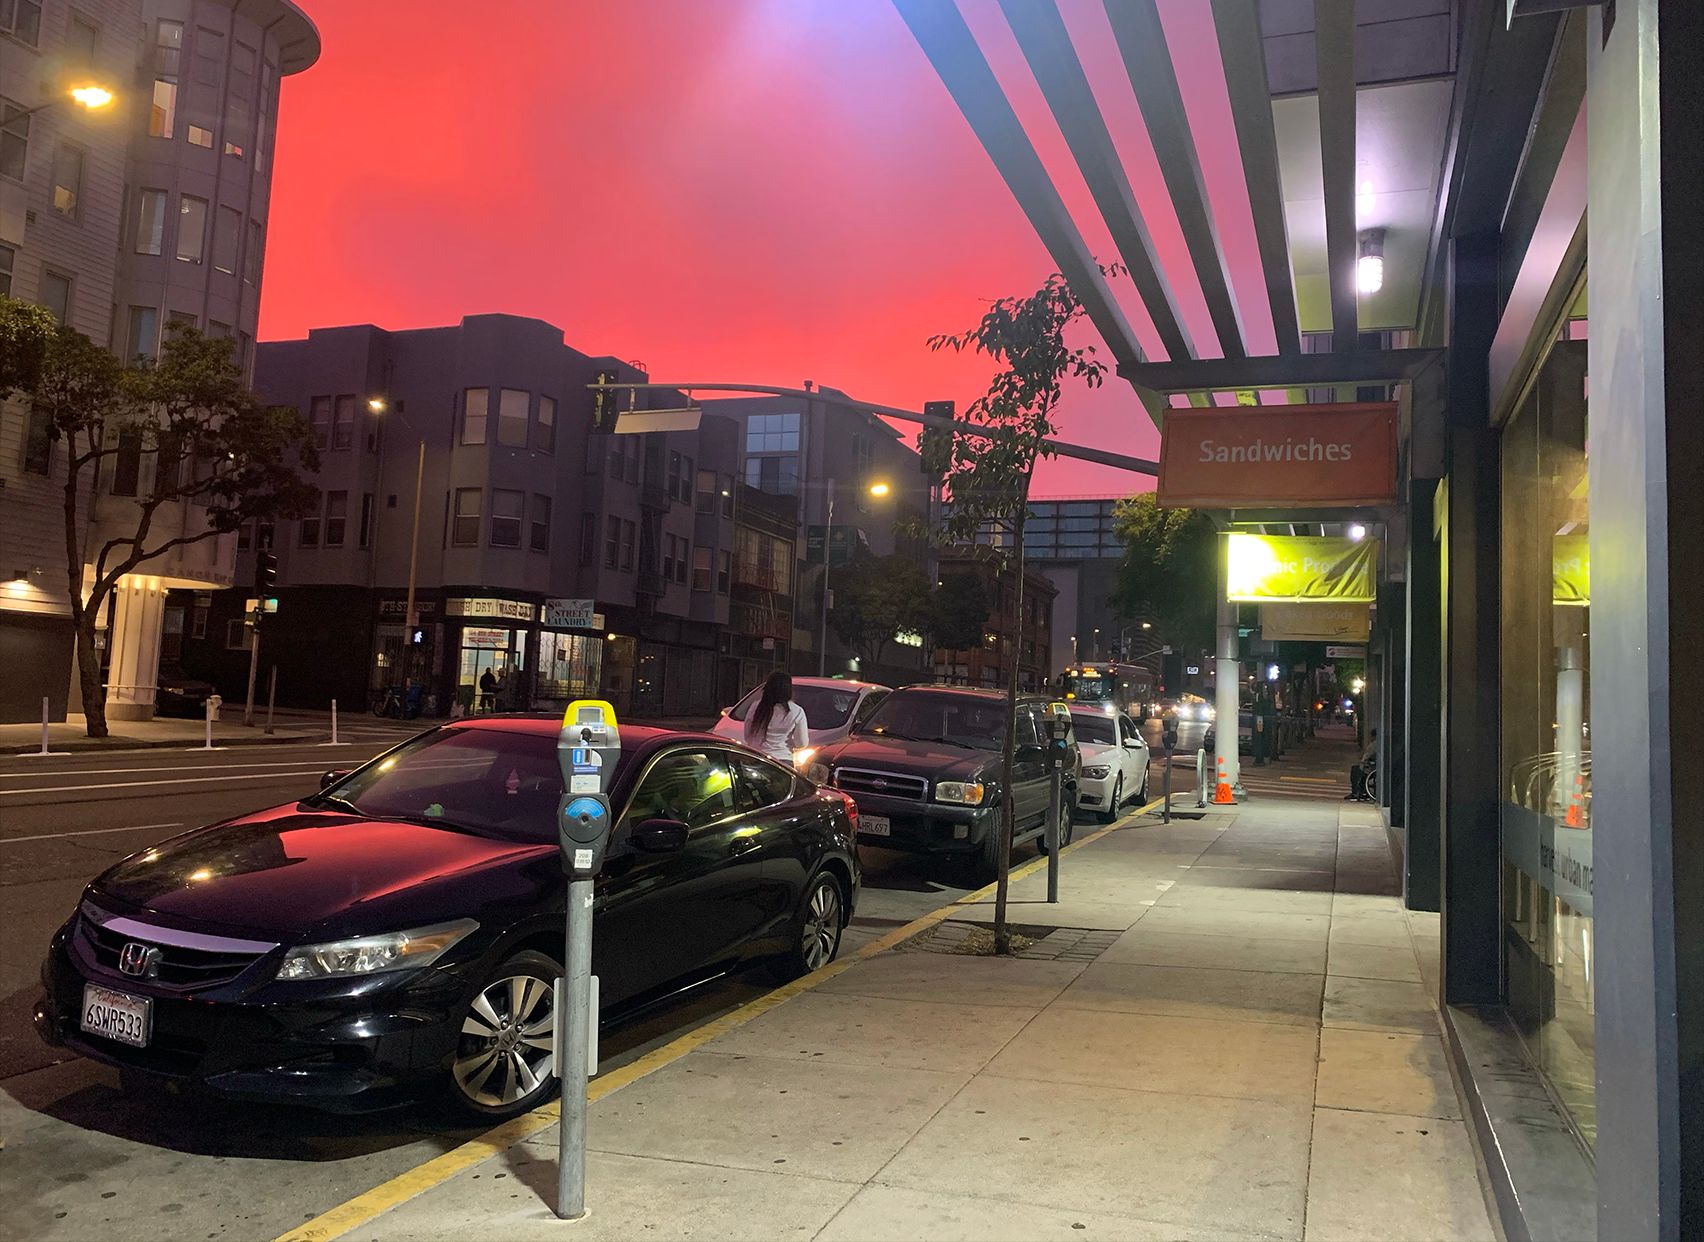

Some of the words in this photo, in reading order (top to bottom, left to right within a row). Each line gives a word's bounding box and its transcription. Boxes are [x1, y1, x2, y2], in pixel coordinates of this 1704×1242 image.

[1199, 438, 1352, 463] Sandwiches
[475, 602, 492, 612] DRY
[554, 609, 590, 618] STREET
[547, 617, 586, 626] LAUNDRY
[861, 822, 888, 833] HRL697
[86, 1004, 142, 1038] 6SWR533
